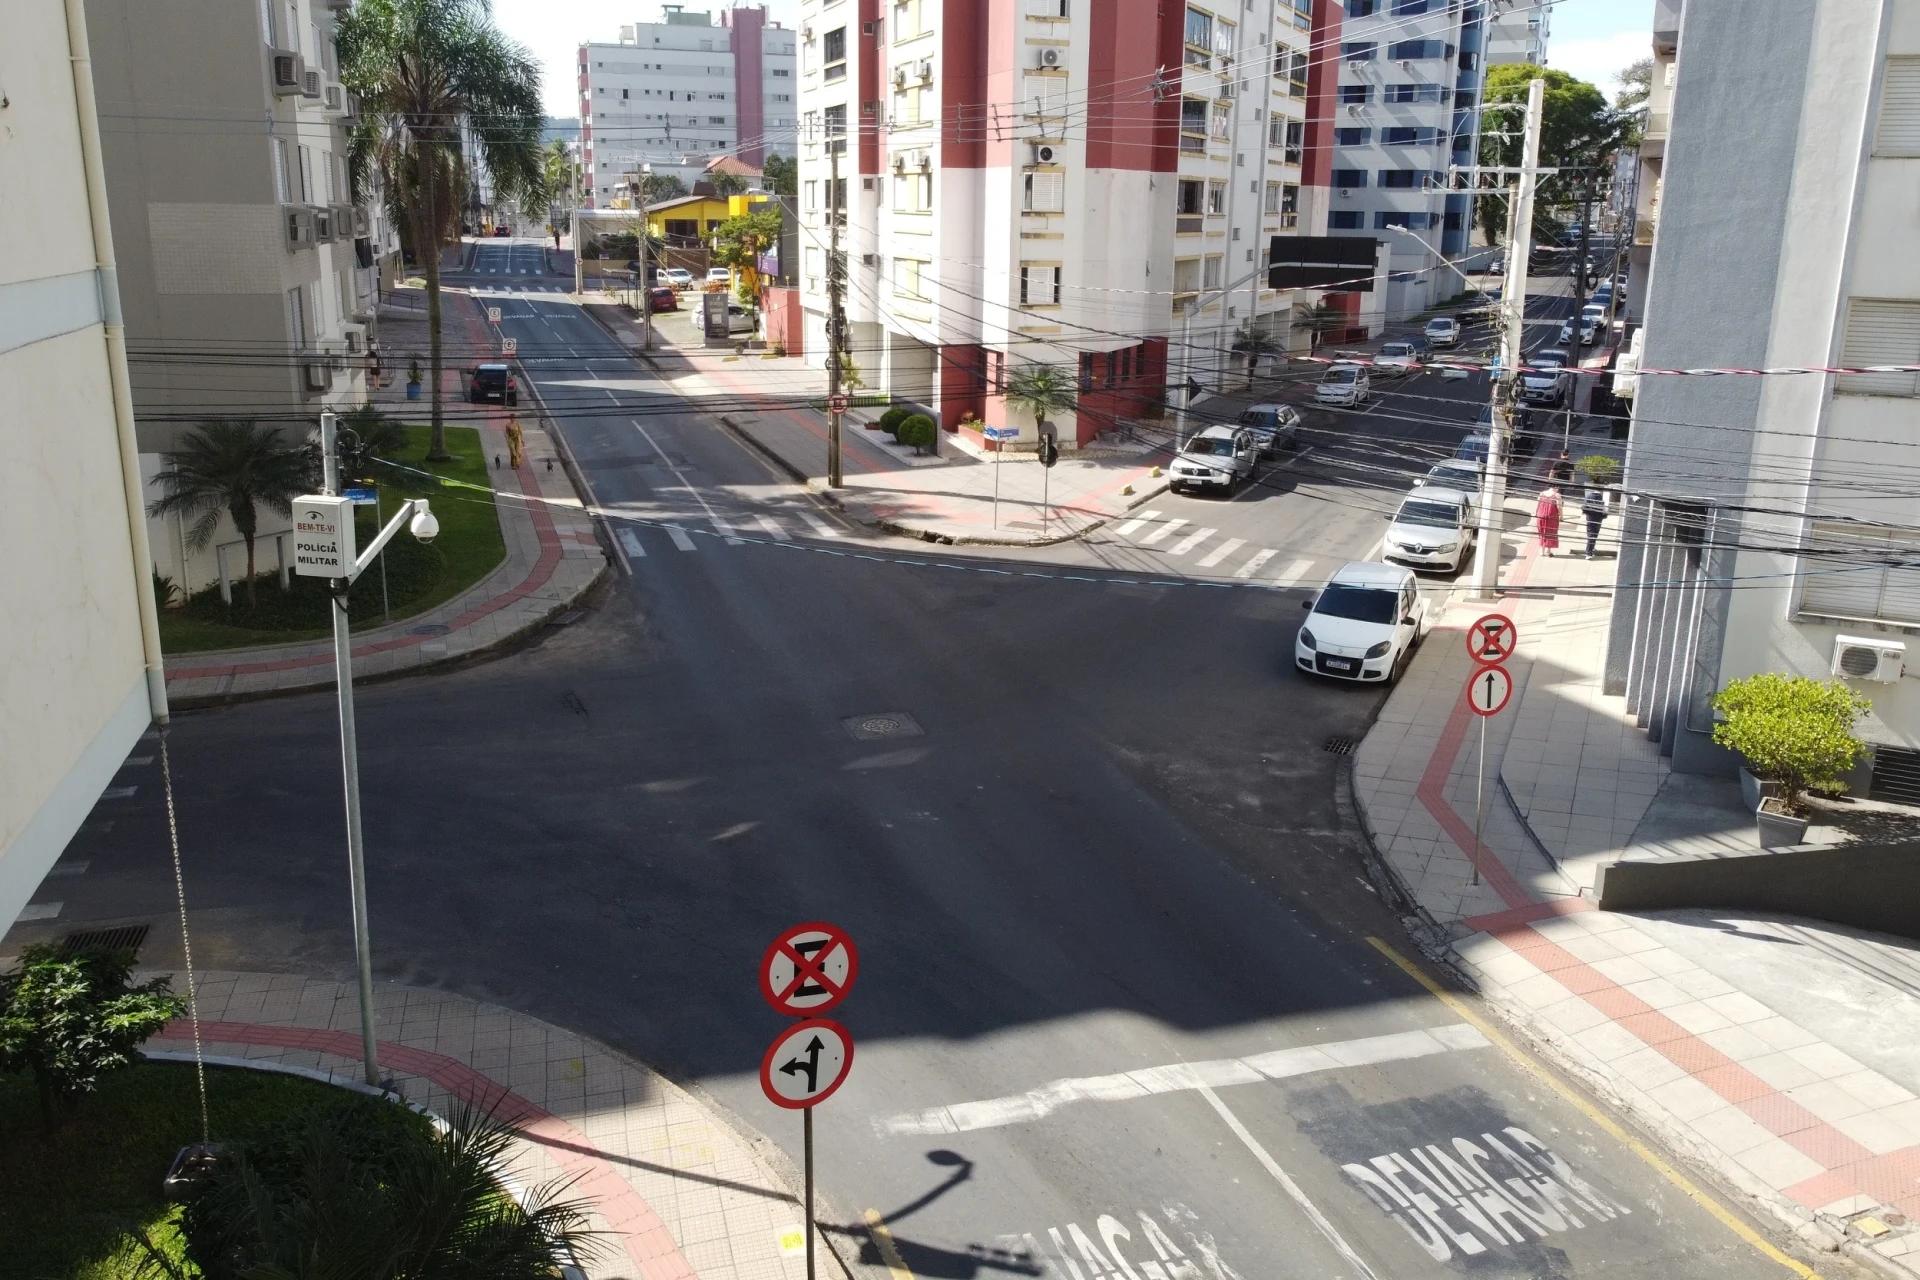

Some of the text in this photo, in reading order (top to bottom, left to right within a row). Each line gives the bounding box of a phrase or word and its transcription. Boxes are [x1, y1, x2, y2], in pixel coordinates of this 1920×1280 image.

[297, 522, 336, 533] BEM-TE-VI
[297, 555, 338, 566] MILITAR
[1341, 1126, 1632, 1263] DEVAGAR
